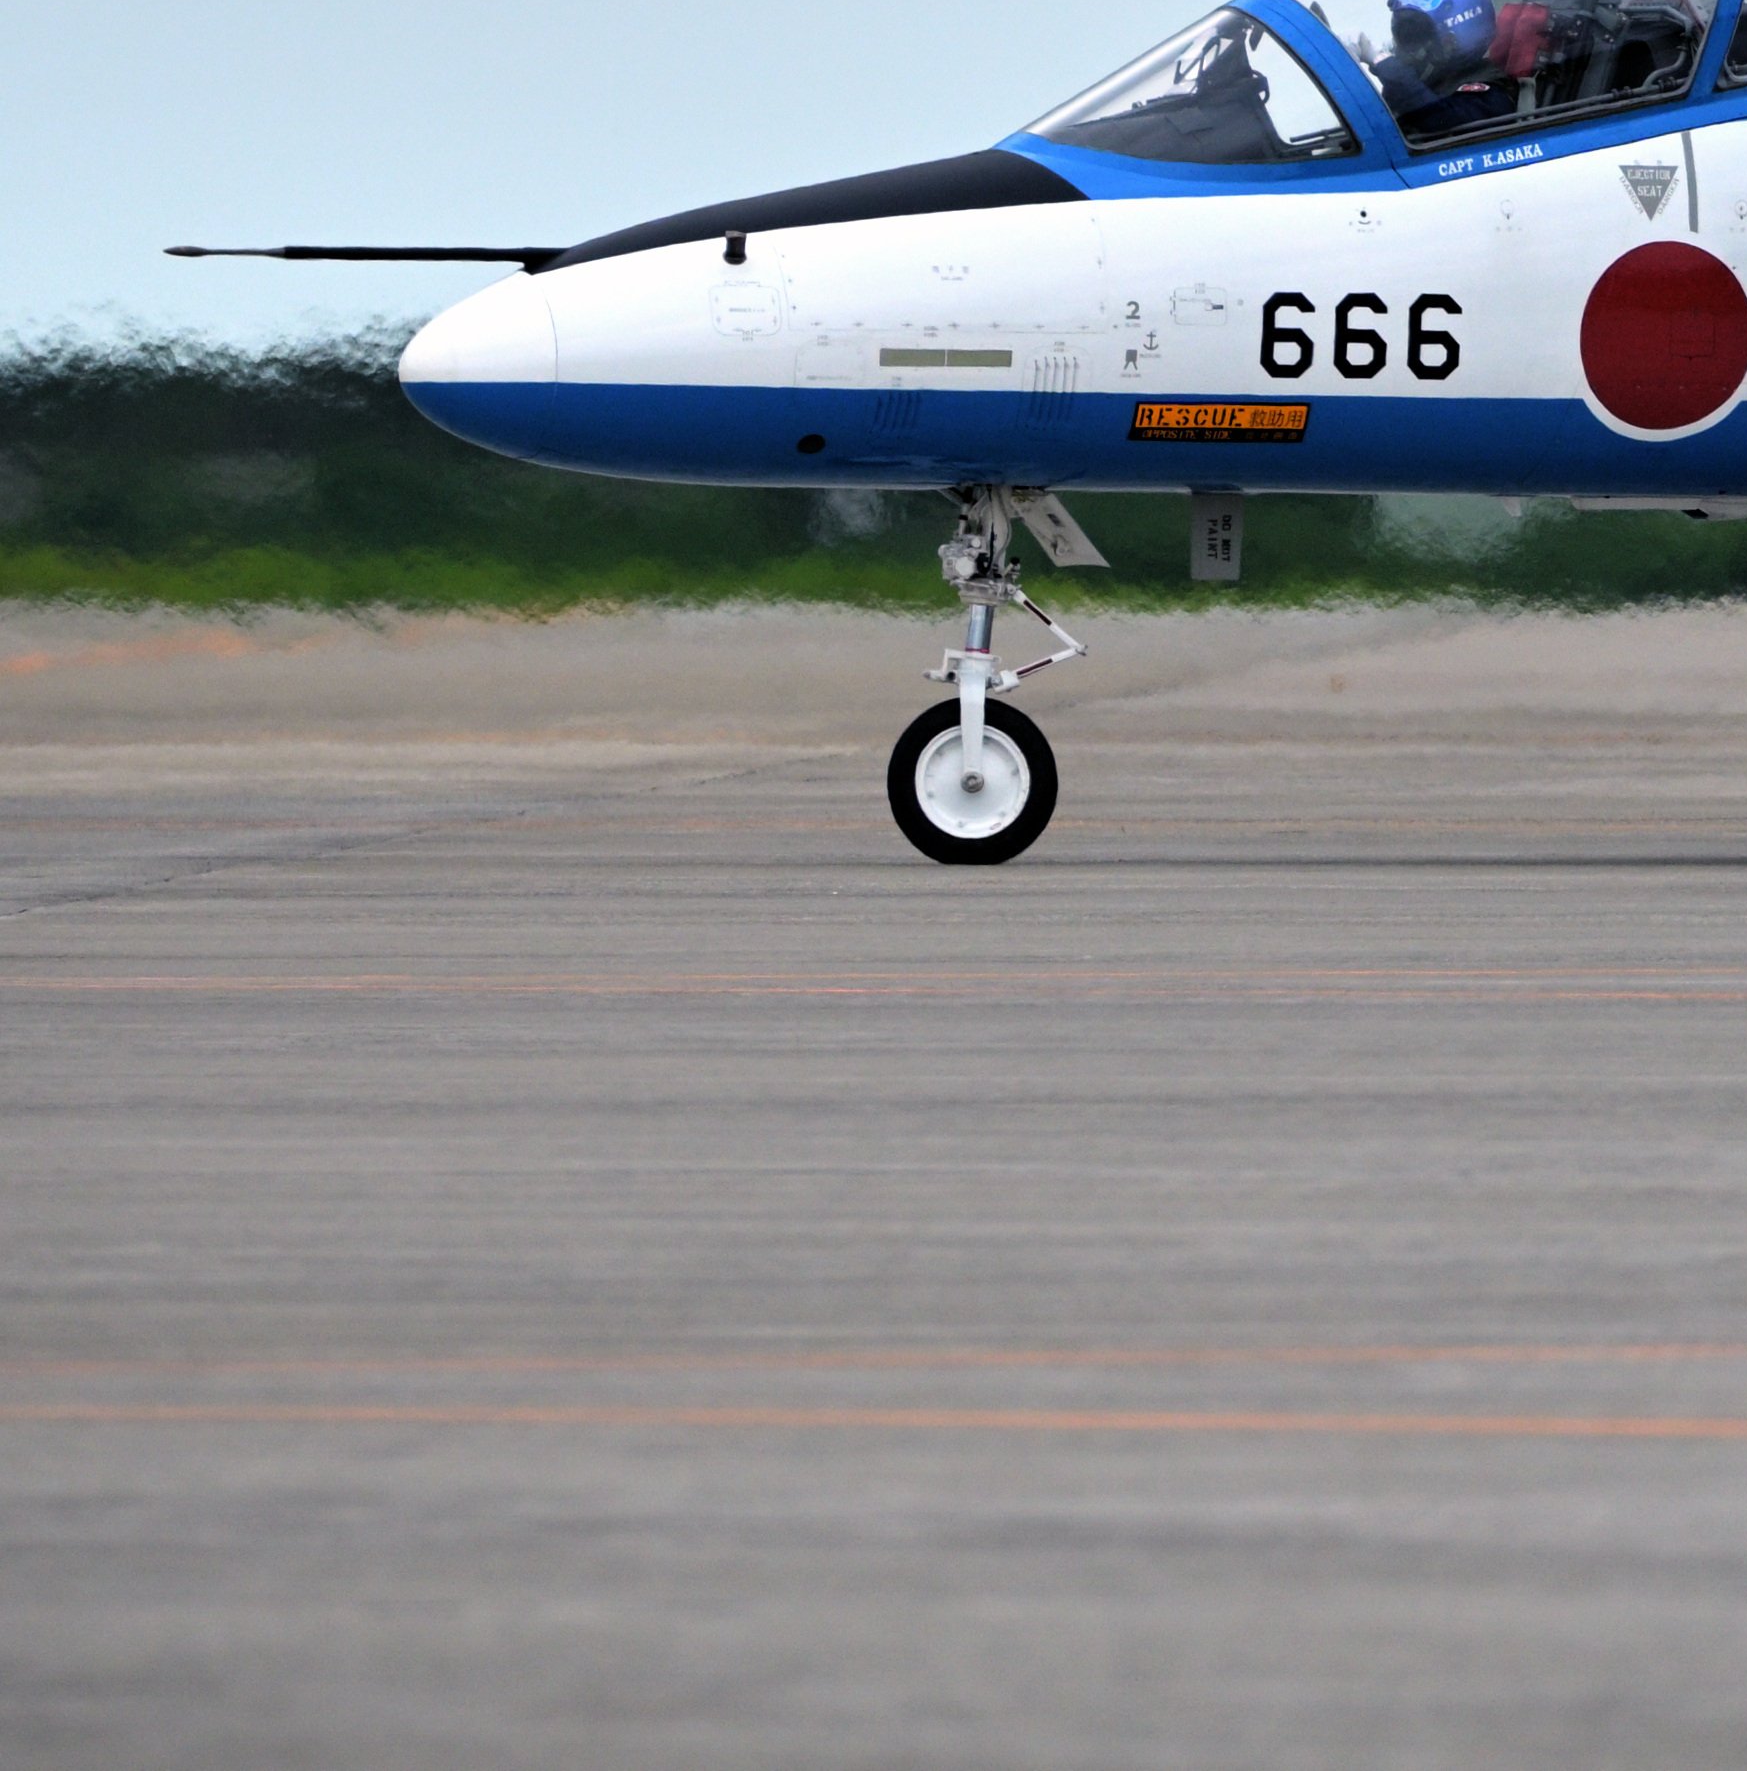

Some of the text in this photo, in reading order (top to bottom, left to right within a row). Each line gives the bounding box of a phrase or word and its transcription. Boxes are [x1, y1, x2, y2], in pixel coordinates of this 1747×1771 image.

[1443, 6, 1482, 28] TAKA
[1438, 144, 1544, 177] CAPT K.ASAKA
[1627, 168, 1671, 180] EJECTION
[1637, 185, 1662, 197] SEAT
[1260, 292, 1463, 380] 666
[1138, 407, 1304, 428] RESCUE 救助用
[1141, 430, 1198, 439] OPPOSITE
[1204, 430, 1233, 440] SIDE
[1207, 518, 1219, 559] PAINT
